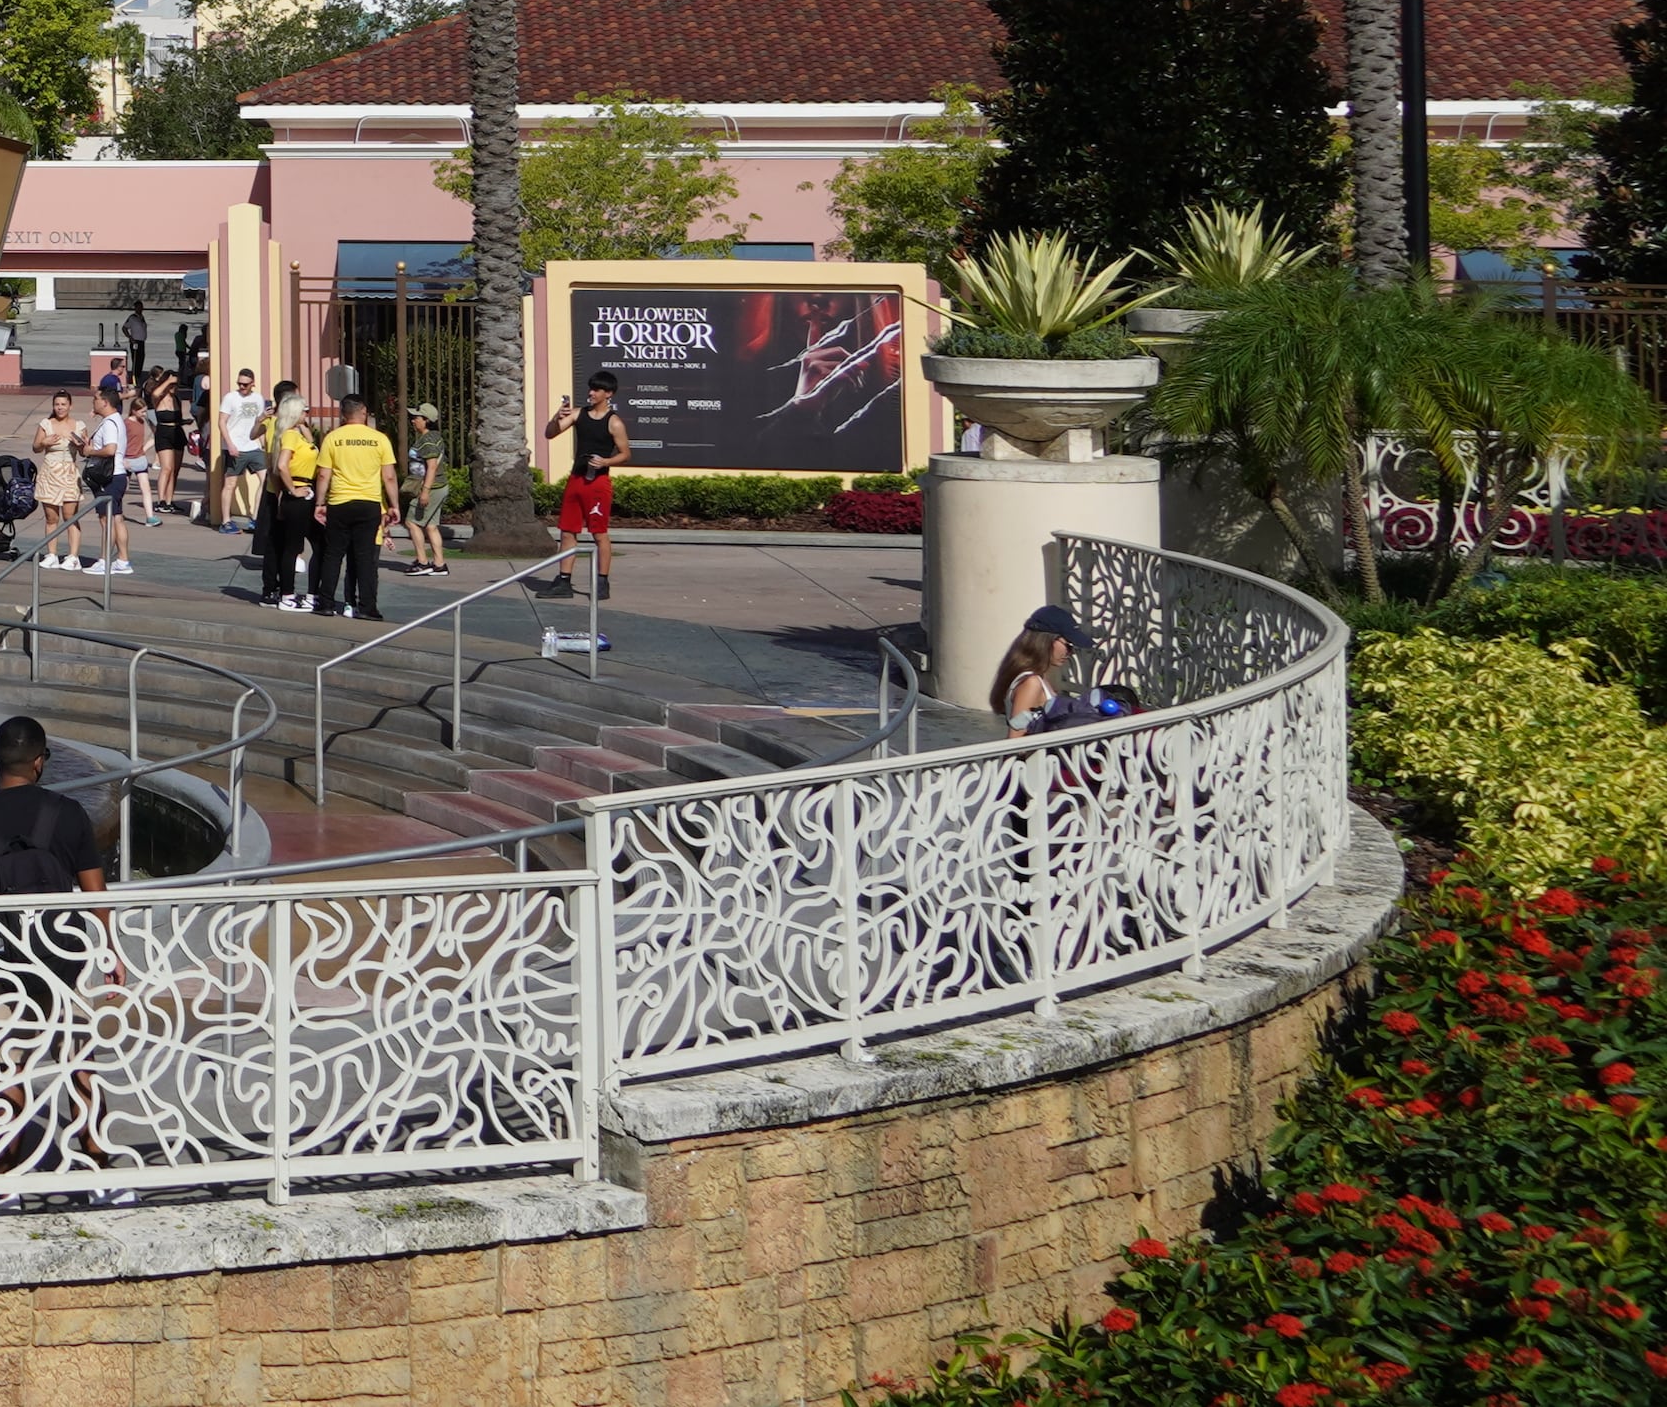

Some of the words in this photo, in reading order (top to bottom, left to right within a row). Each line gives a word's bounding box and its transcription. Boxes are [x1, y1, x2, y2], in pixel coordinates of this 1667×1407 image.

[4, 231, 42, 244] EXIT
[49, 231, 94, 244] ONLY
[597, 306, 707, 322] HALLOWEEN
[589, 321, 718, 354] HORROR
[623, 345, 687, 360] NIGHTS
[627, 361, 652, 369] NIGHTS
[628, 398, 678, 407] GHOSTBUSTERS
[687, 399, 722, 408] INSIDIOUS
[334, 439, 343, 447] LE
[346, 439, 379, 447] BUDDIES
